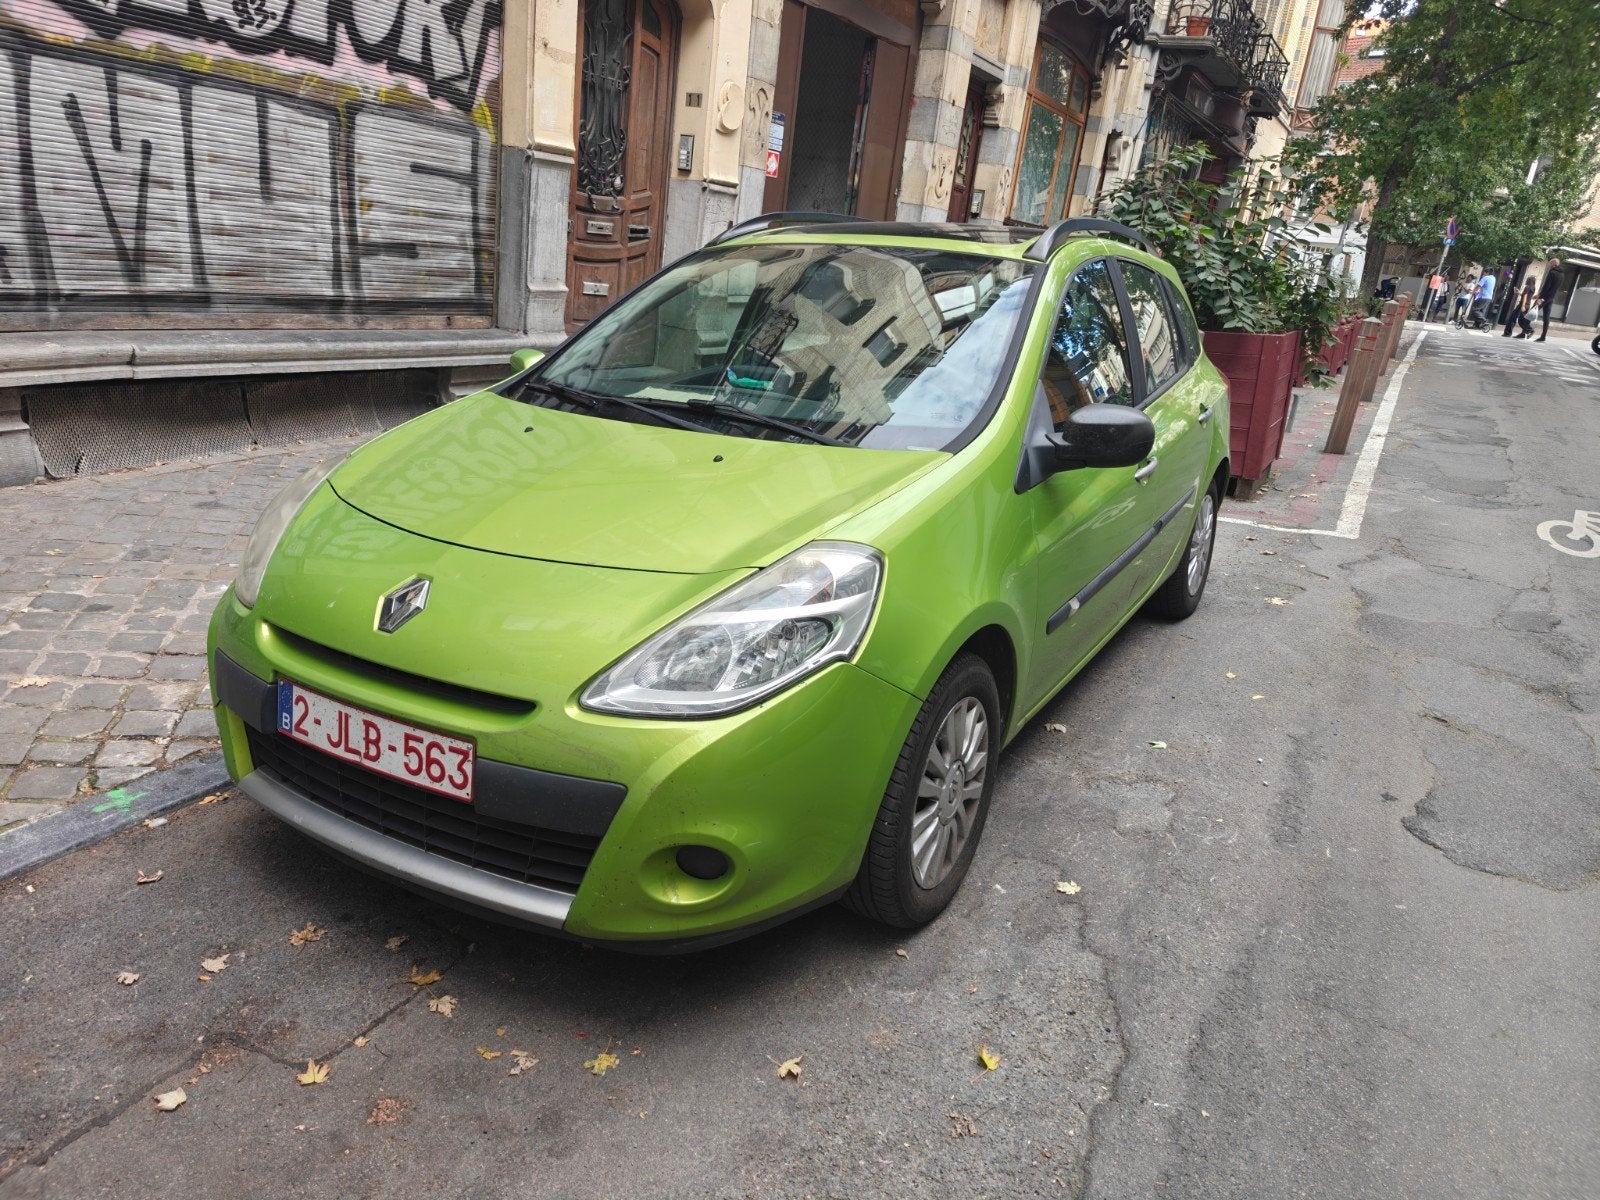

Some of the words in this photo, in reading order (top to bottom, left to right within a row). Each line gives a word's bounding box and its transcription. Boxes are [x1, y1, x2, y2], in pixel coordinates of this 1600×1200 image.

[688, 94, 700, 107] 11
[282, 713, 291, 730] B
[294, 694, 469, 790] 2-JLB-563
